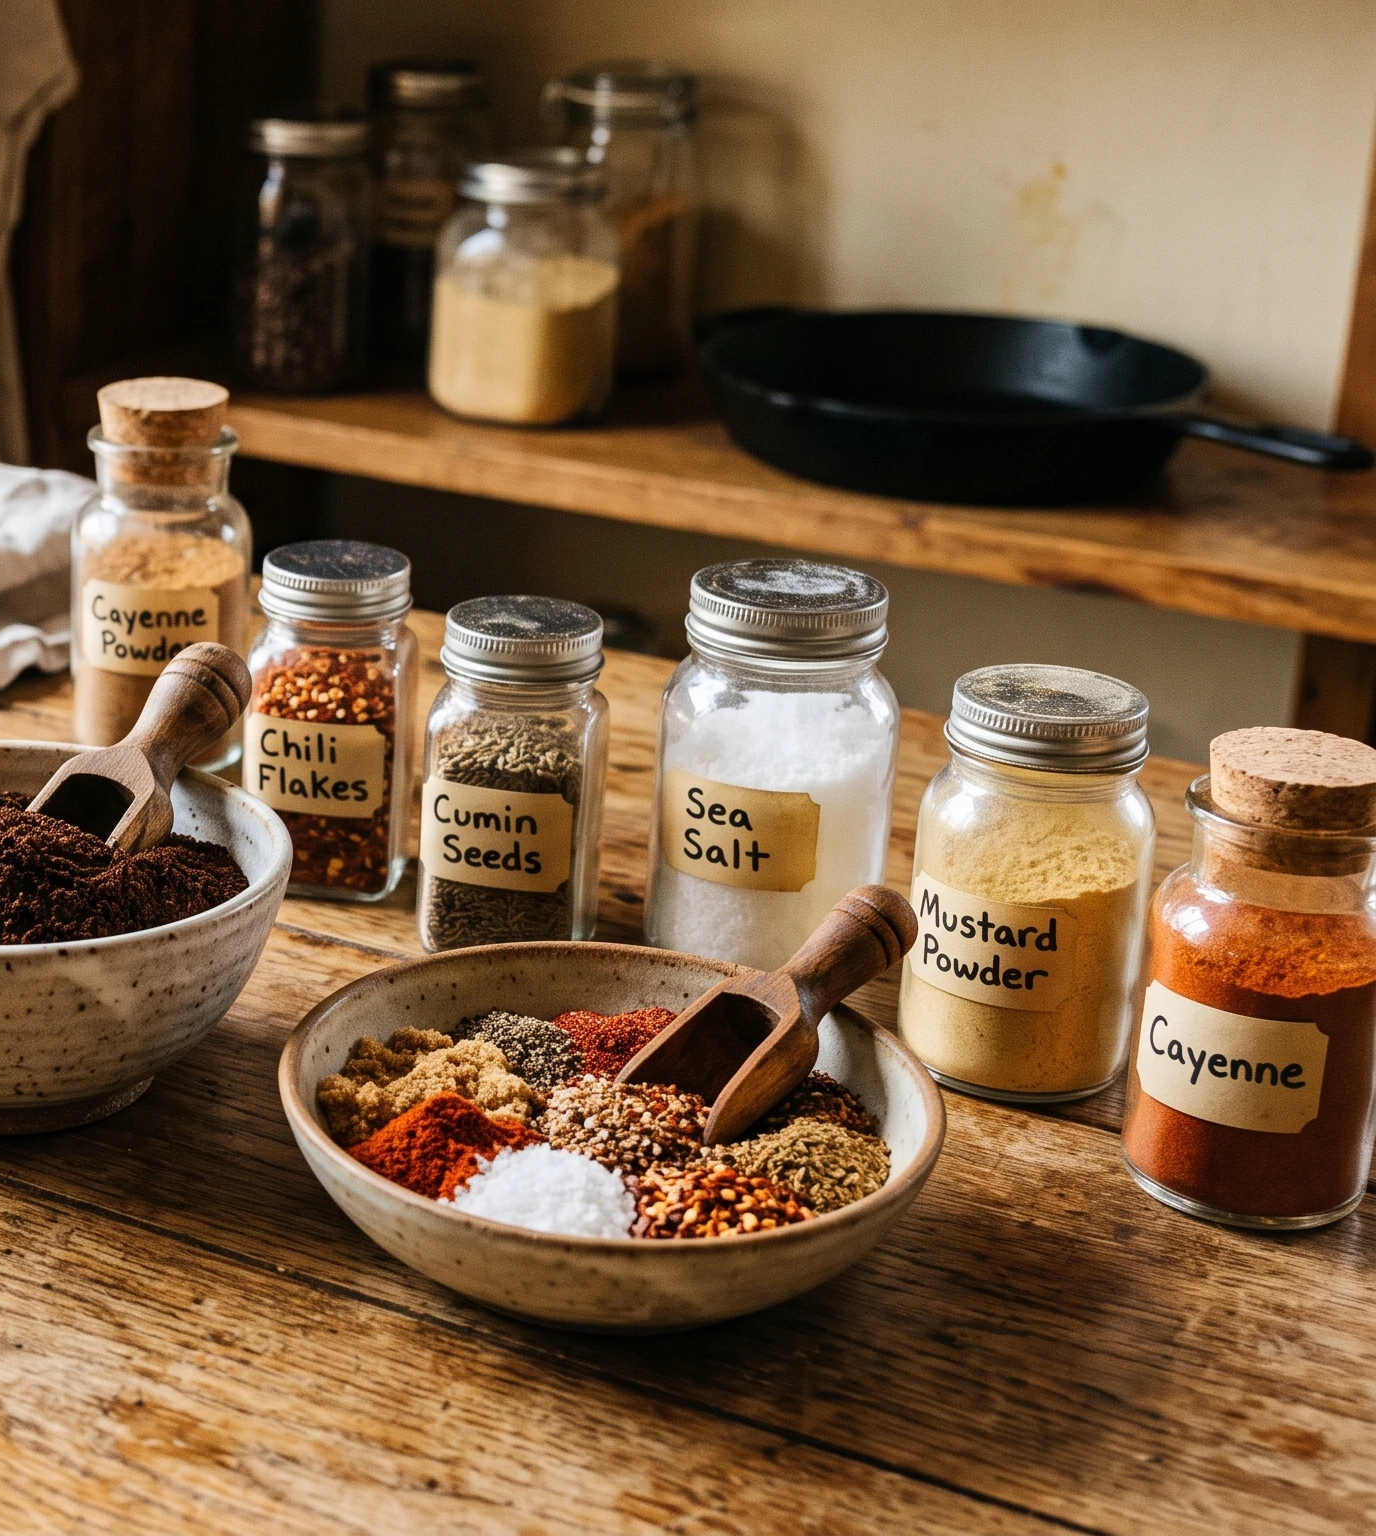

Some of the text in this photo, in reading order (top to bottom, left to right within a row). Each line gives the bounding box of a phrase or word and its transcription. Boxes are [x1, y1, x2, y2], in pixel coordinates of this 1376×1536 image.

[92, 594, 207, 634] Cayenne
[260, 728, 337, 764] Chili
[258, 763, 369, 802] Flakes
[434, 793, 537, 835] Cumin
[686, 787, 753, 831] Sea
[442, 834, 542, 874] Seeds
[683, 827, 771, 872] Salt
[919, 888, 1058, 951] Mustard
[923, 933, 1049, 991] Powder
[1149, 1014, 1306, 1090] Cayenne
